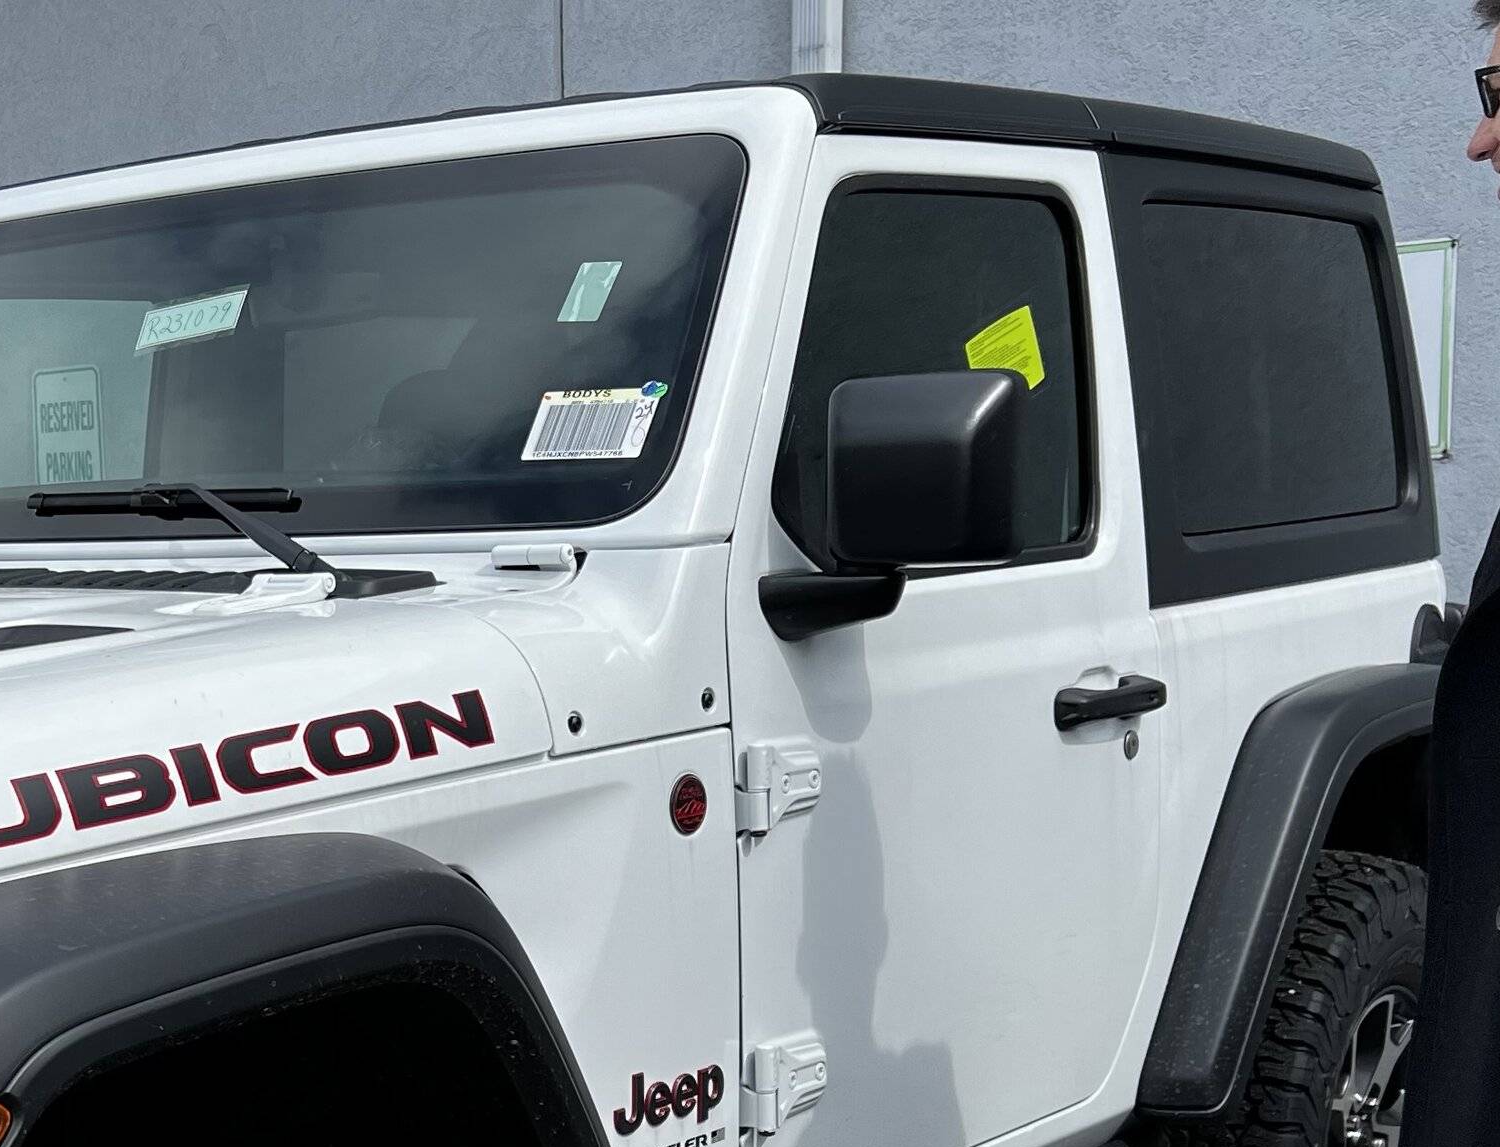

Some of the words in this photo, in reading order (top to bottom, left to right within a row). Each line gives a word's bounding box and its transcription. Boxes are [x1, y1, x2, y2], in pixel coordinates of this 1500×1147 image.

[40, 400, 94, 433] RESERVED
[46, 449, 93, 482] PARKING
[613, 1064, 725, 1136] Jeep
